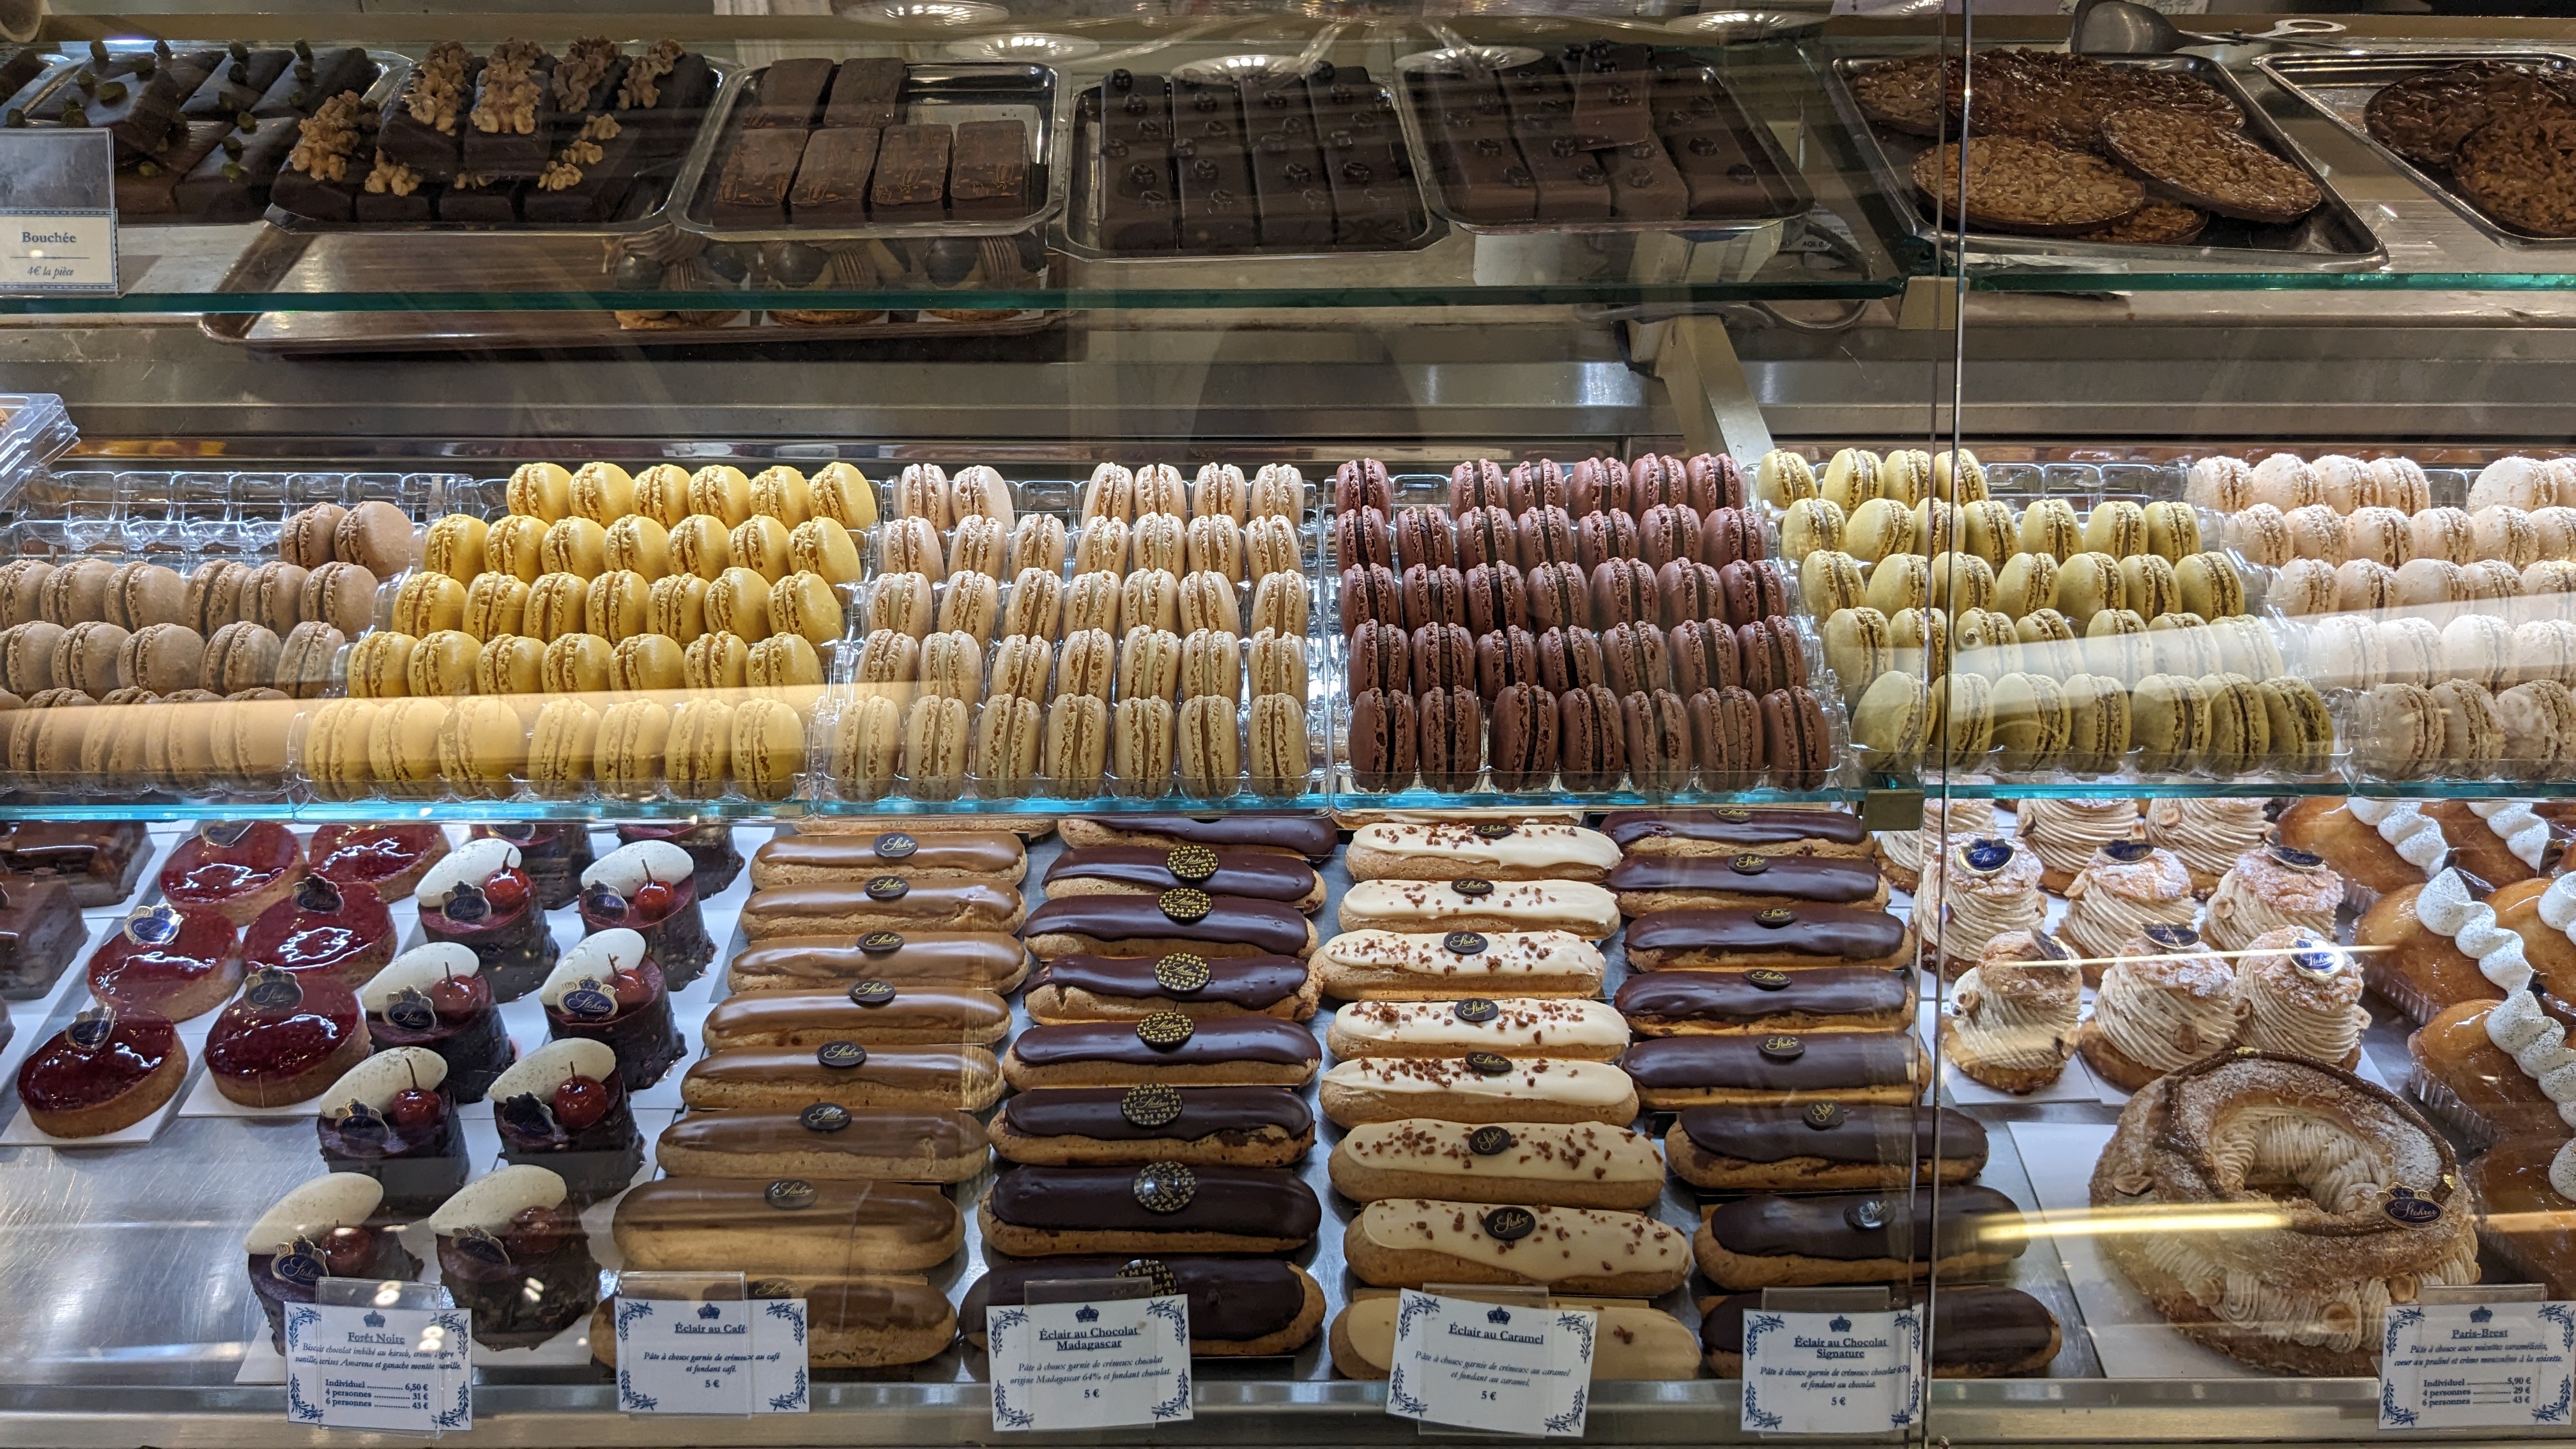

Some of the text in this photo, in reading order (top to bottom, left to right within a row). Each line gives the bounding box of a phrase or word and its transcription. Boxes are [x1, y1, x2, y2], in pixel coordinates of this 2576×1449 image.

[22, 232, 77, 242] Bouchée
[43, 266, 51, 275] la
[52, 266, 73, 279] pièce
[567, 993, 610, 1013] Stohrer
[2389, 1201, 2437, 1218] Stohrer
[675, 1322, 705, 1332] Éclair
[724, 1324, 747, 1333] Café
[1039, 1328, 1071, 1339] Éclair
[1091, 1326, 1138, 1337] Chocolat
[1449, 1322, 1481, 1337] Éclair
[1501, 1330, 1544, 1344] Caramel
[348, 1332, 405, 1343] Forêt Noire
[2452, 1329, 2508, 1338] Paris-Brest
[1057, 1340, 1122, 1351] Madagascar
[1795, 1335, 1825, 1347] Éclair
[1843, 1338, 1887, 1346] Chocolat
[303, 1343, 324, 1351] Biscuit
[325, 1346, 351, 1354] chocolat
[354, 1347, 375, 1355] imbibé
[388, 1349, 411, 1358] kirsch,
[1817, 1349, 1864, 1360] Signature
[668, 1353, 689, 1361] choux
[691, 1353, 712, 1362] garnie
[767, 1352, 779, 1361] café
[2425, 1357, 2450, 1367] praliné
[296, 1356, 318, 1364] vanille,
[341, 1358, 372, 1367] Amarena
[383, 1361, 408, 1370] ganache
[1018, 1363, 1034, 1372] Pâte
[1044, 1362, 1066, 1370] choux
[1068, 1361, 1090, 1372] garnie
[1103, 1359, 1133, 1367] crémeux
[1135, 1356, 1162, 1365] chocolat
[1416, 1351, 1431, 1361] Pâte
[1441, 1356, 1462, 1366] choux
[1464, 1361, 1487, 1370] garnie
[1499, 1363, 1528, 1373] crémeux
[1542, 1367, 1570, 1376] caramel
[693, 1365, 720, 1374] fondant
[1759, 1367, 1775, 1375] Pâte
[1841, 1368, 1868, 1376] crémeux
[1010, 1377, 1034, 1386] origine
[1036, 1375, 1080, 1384] Madagascar
[1111, 1370, 1139, 1381] fondant
[1142, 1368, 1171, 1377] chocolat.
[1458, 1372, 1487, 1382] fondant
[1501, 1379, 1529, 1387] caramel.
[326, 1379, 365, 1388] Individuel
[1808, 1381, 1835, 1390] fondant
[332, 1390, 372, 1399] personnes
[1084, 1389, 1099, 1398] 5 €
[1482, 1391, 1496, 1400] 5 €
[2430, 1389, 2471, 1399] personnes
[332, 1399, 372, 1408] personnes
[2429, 1399, 2470, 1407] personnes
